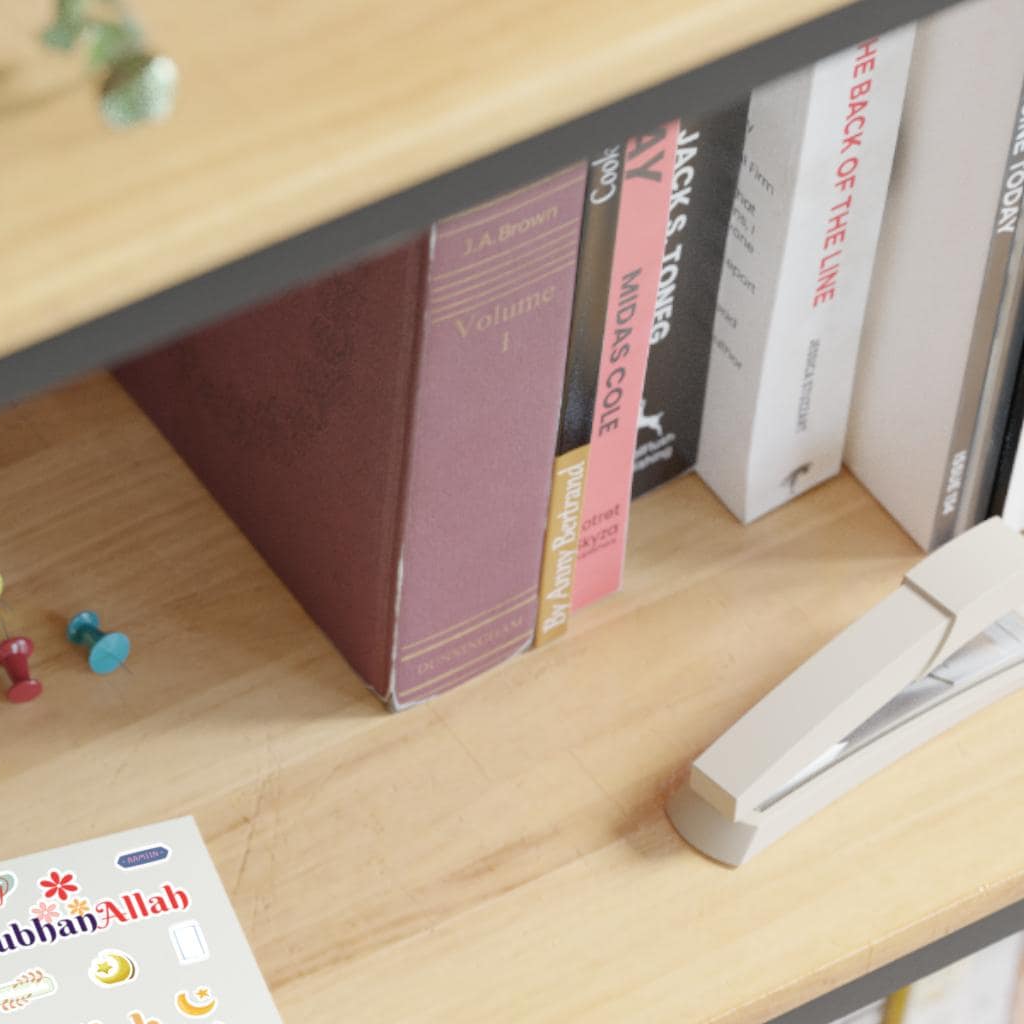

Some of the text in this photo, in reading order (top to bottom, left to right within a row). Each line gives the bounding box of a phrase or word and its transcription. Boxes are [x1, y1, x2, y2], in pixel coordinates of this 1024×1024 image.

[840, 79, 872, 154] BACK
[669, 129, 700, 210] JACK
[835, 157, 859, 192] OF
[498, 205, 559, 242] Brown
[824, 195, 852, 250] THE
[811, 250, 842, 309] LINE
[454, 285, 557, 339] Volume
[599, 266, 642, 438] MIDAS COLE
[552, 459, 585, 550] Bertrand
